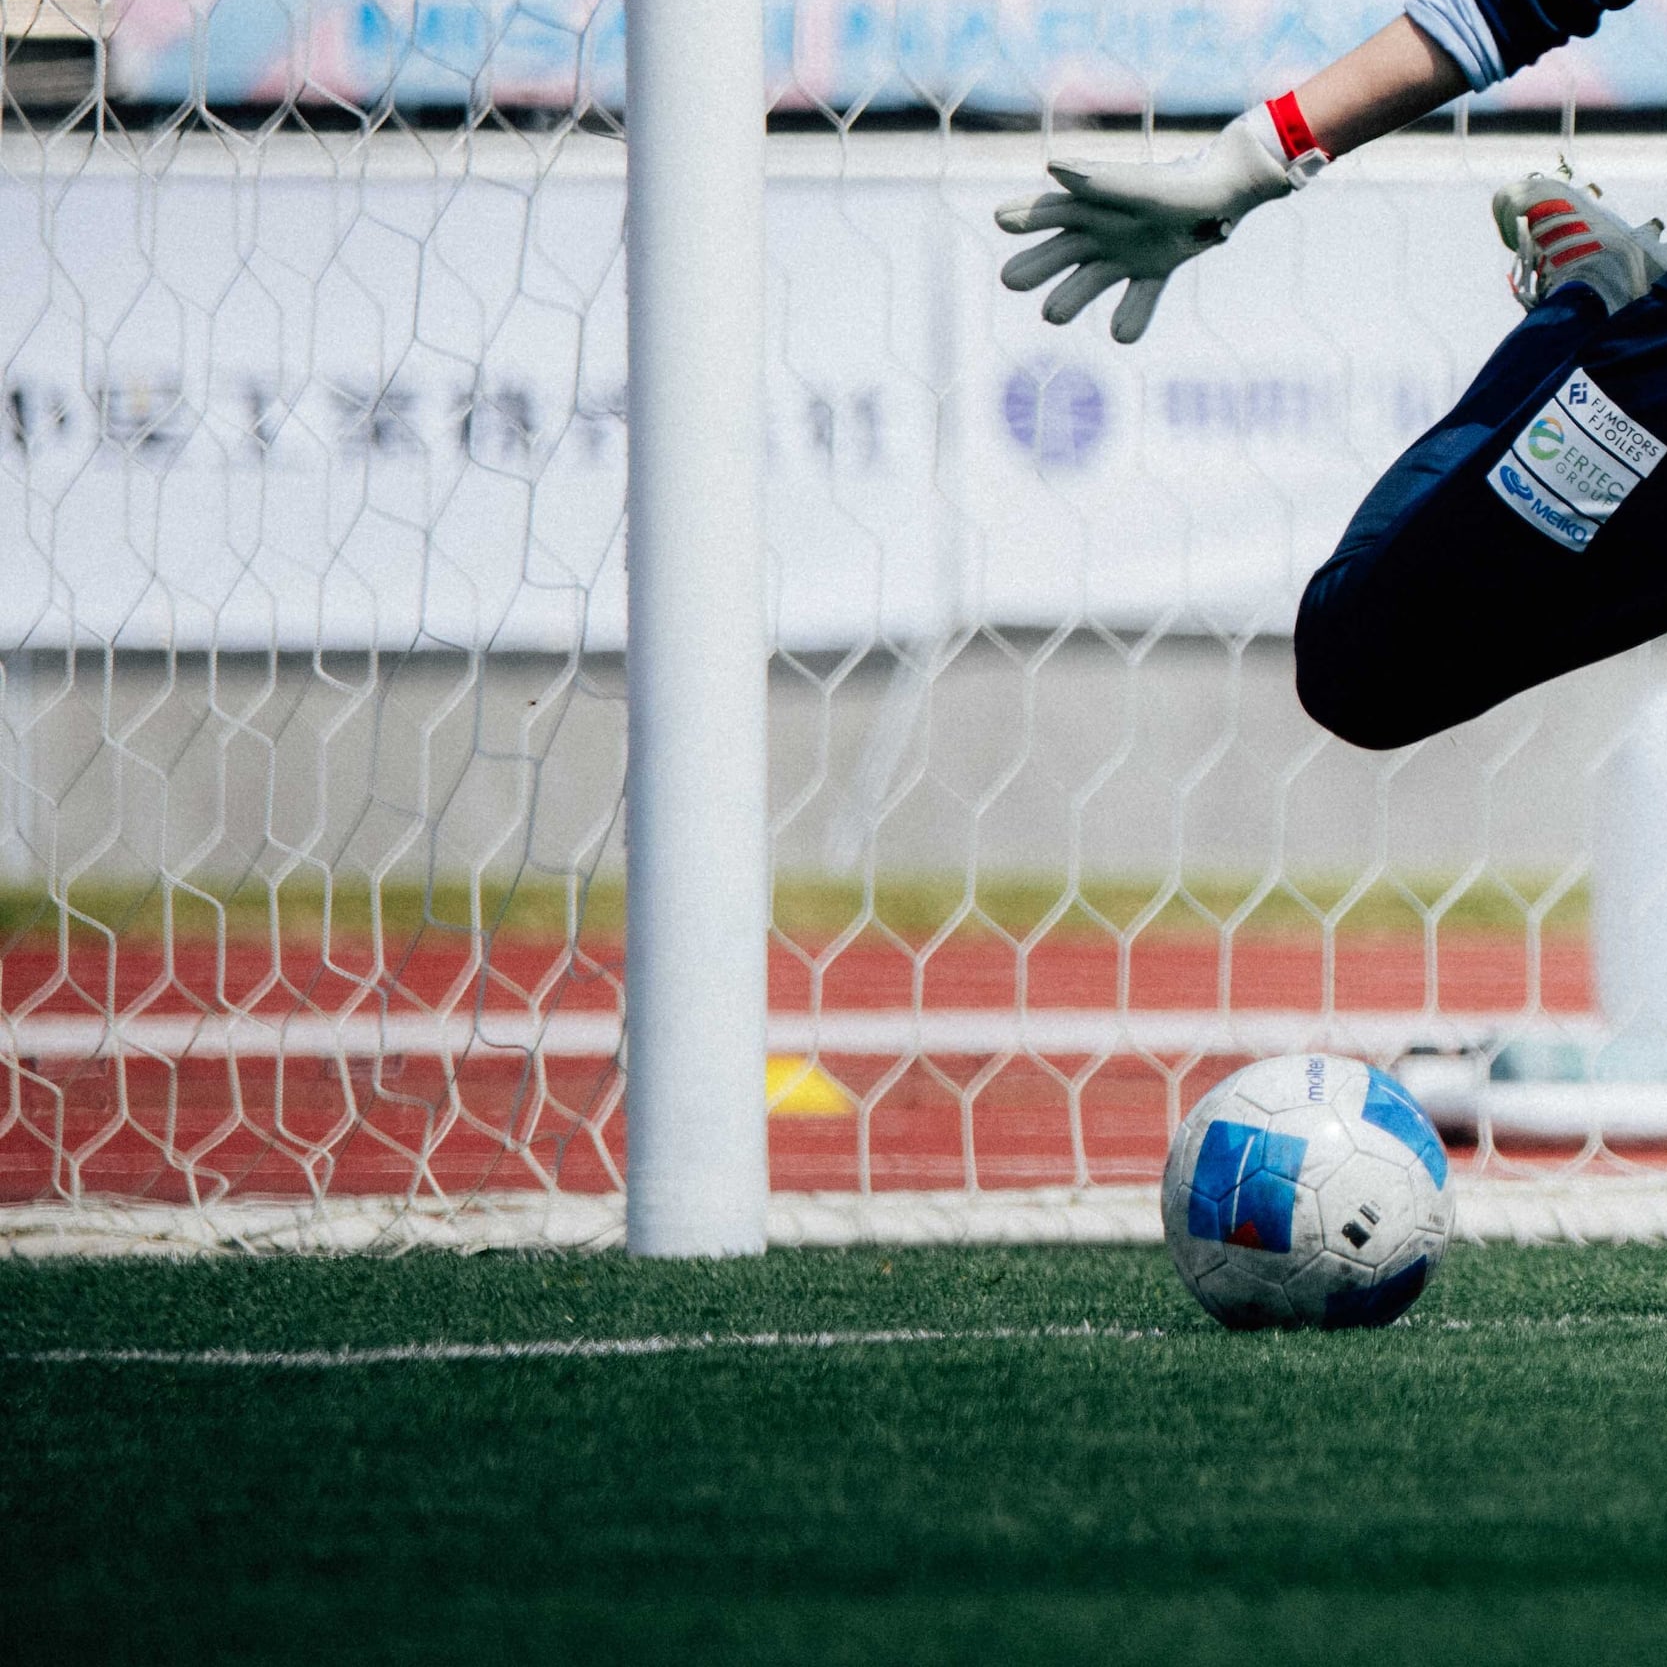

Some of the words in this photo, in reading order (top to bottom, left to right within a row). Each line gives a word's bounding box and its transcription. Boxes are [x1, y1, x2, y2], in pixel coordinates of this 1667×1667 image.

[1604, 411, 1659, 457] MOTORS
[1604, 429, 1643, 462] OILES
[1555, 462, 1614, 508] GROUP
[1563, 446, 1625, 498] ERTEC
[1531, 498, 1588, 544] MEIKO
